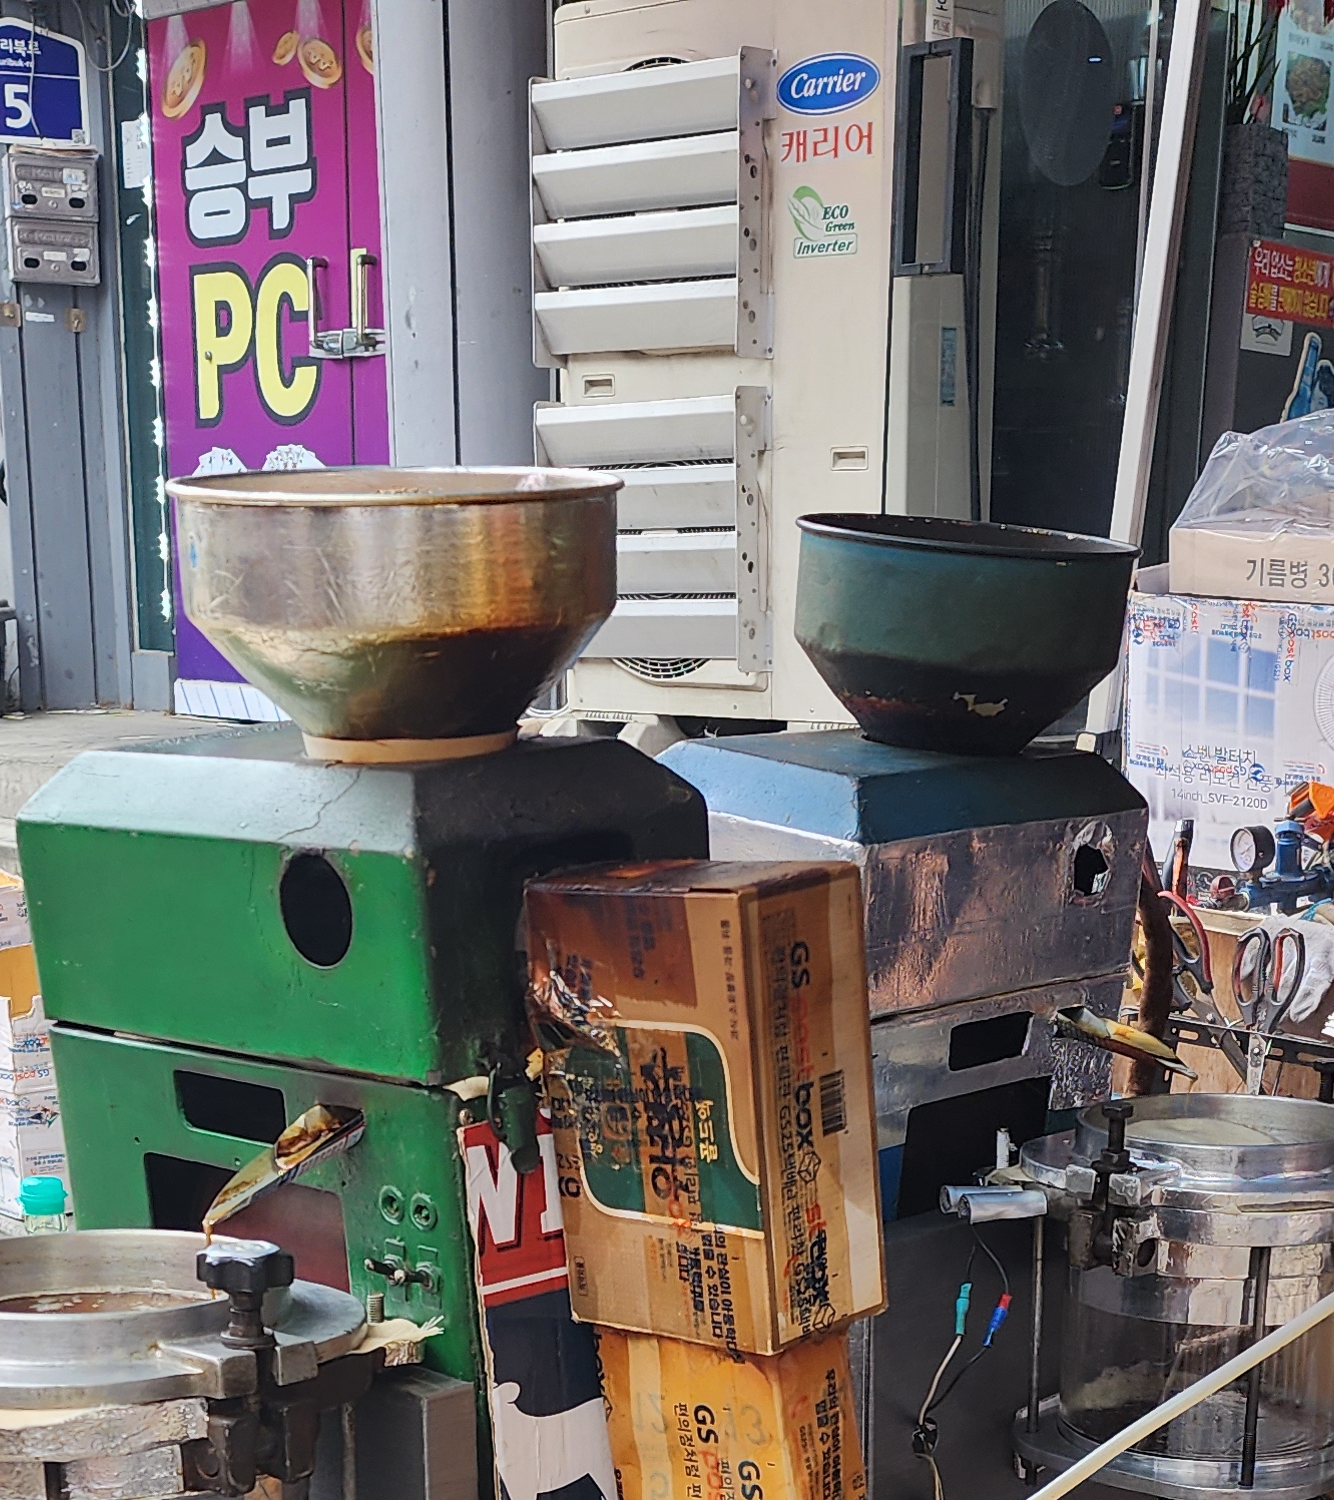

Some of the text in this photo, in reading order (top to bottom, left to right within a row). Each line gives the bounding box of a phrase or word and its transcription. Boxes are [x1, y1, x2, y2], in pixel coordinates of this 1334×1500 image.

[791, 68, 866, 99] Carrier
[4, 84, 31, 129] 5
[781, 121, 874, 163] 캐리어
[183, 96, 314, 241] 승부
[821, 204, 849, 220] ECO
[825, 221, 855, 232] Green
[797, 238, 854, 256] Inverter
[193, 262, 317, 420] PC
[1245, 557, 1307, 589] 기름병
[791, 941, 810, 989] GS
[707, 1282, 723, 1339] 있습니다
[674, 1403, 701, 1479] 편의점처럼
[694, 1405, 719, 1444] GS
